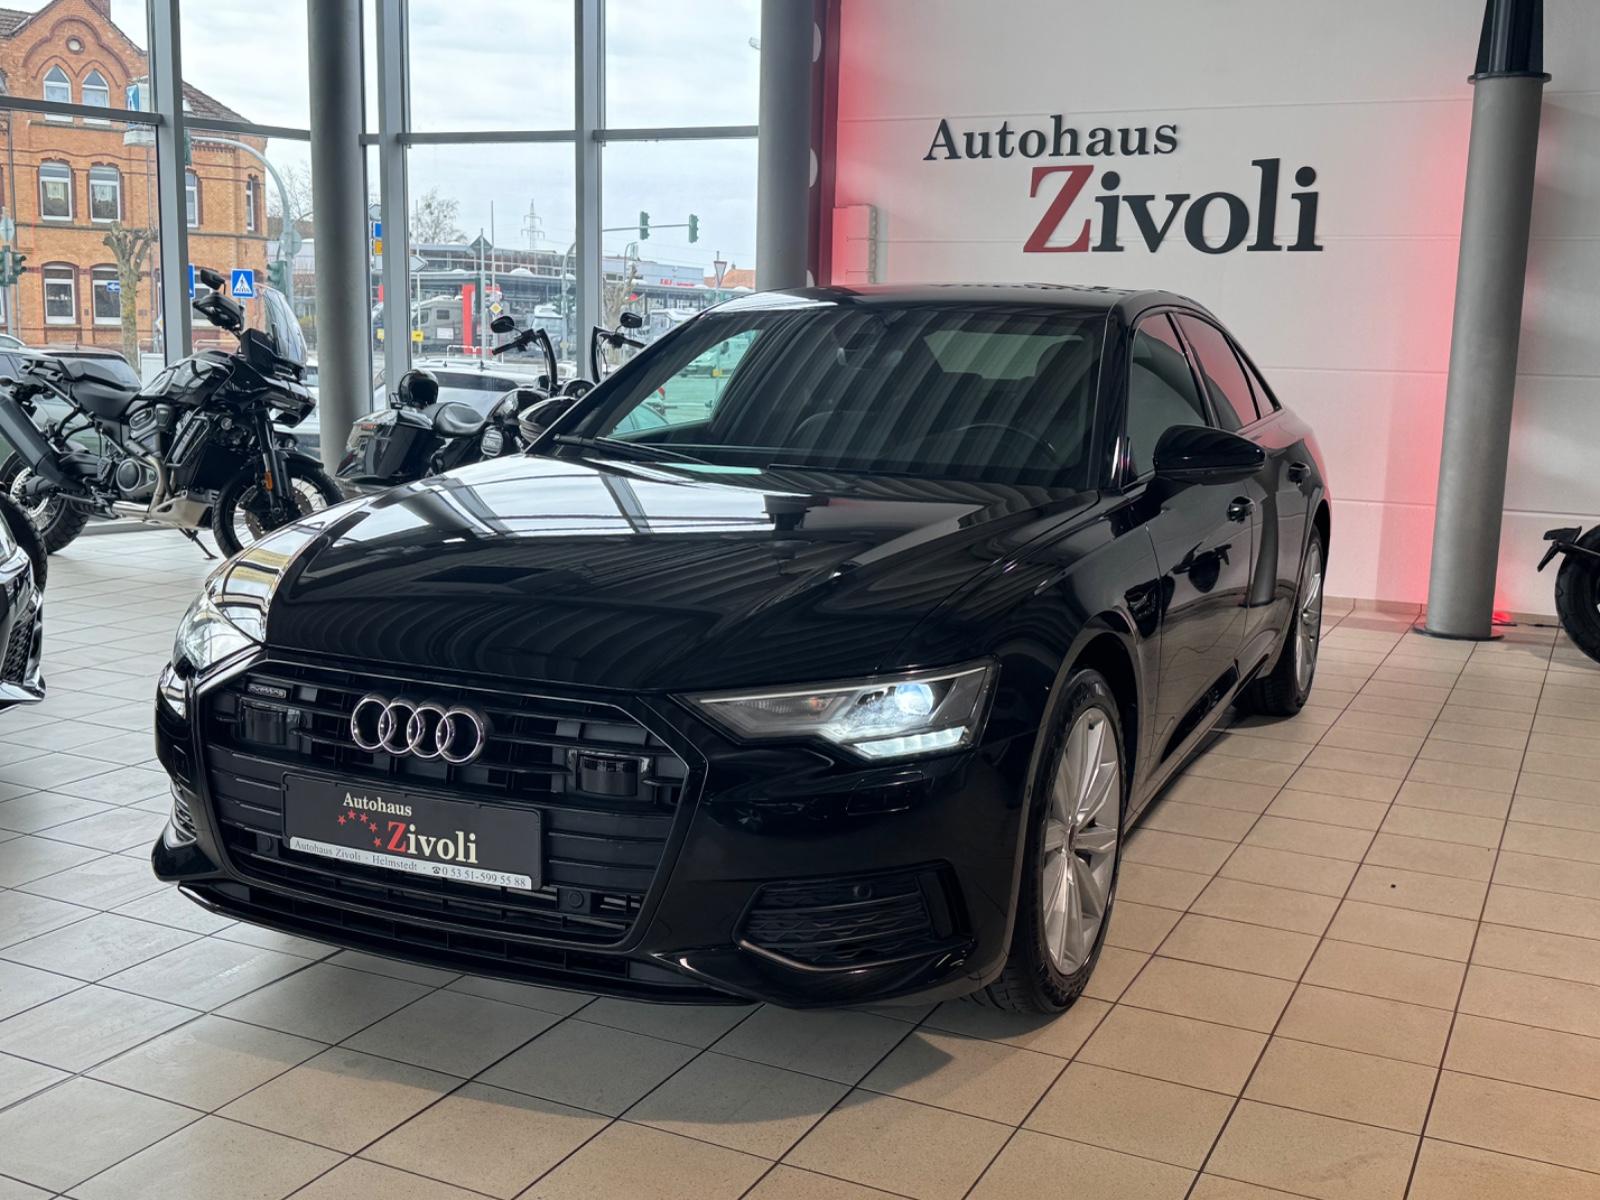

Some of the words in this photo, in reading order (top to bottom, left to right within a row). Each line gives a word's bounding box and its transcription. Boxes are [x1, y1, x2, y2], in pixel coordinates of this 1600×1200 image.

[923, 114, 1177, 161] Autohaus
[1023, 157, 1323, 255] Zivoli
[343, 792, 412, 817] Autohaus
[295, 840, 333, 856] Autohaus
[336, 848, 361, 861] Zivoli
[372, 855, 418, 871] Helmstedt
[387, 820, 478, 864] Zivoli
